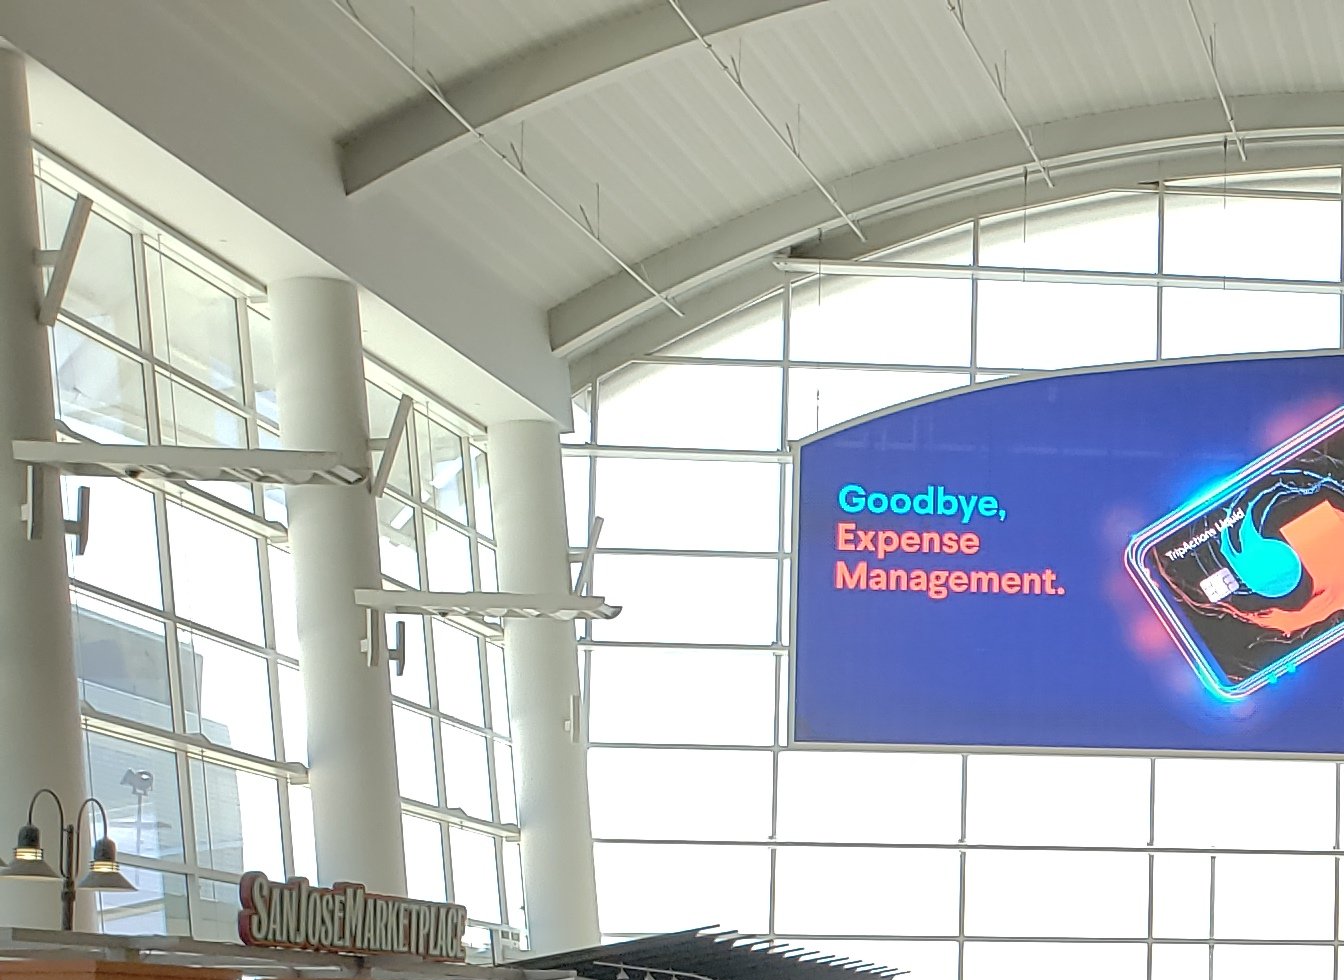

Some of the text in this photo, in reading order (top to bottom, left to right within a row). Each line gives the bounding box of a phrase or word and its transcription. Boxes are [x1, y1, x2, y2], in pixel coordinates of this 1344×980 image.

[838, 484, 1006, 524] Goodbye,
[837, 522, 980, 559] Expense
[1165, 528, 1217, 560] TripActions
[834, 560, 1066, 599] Management.
